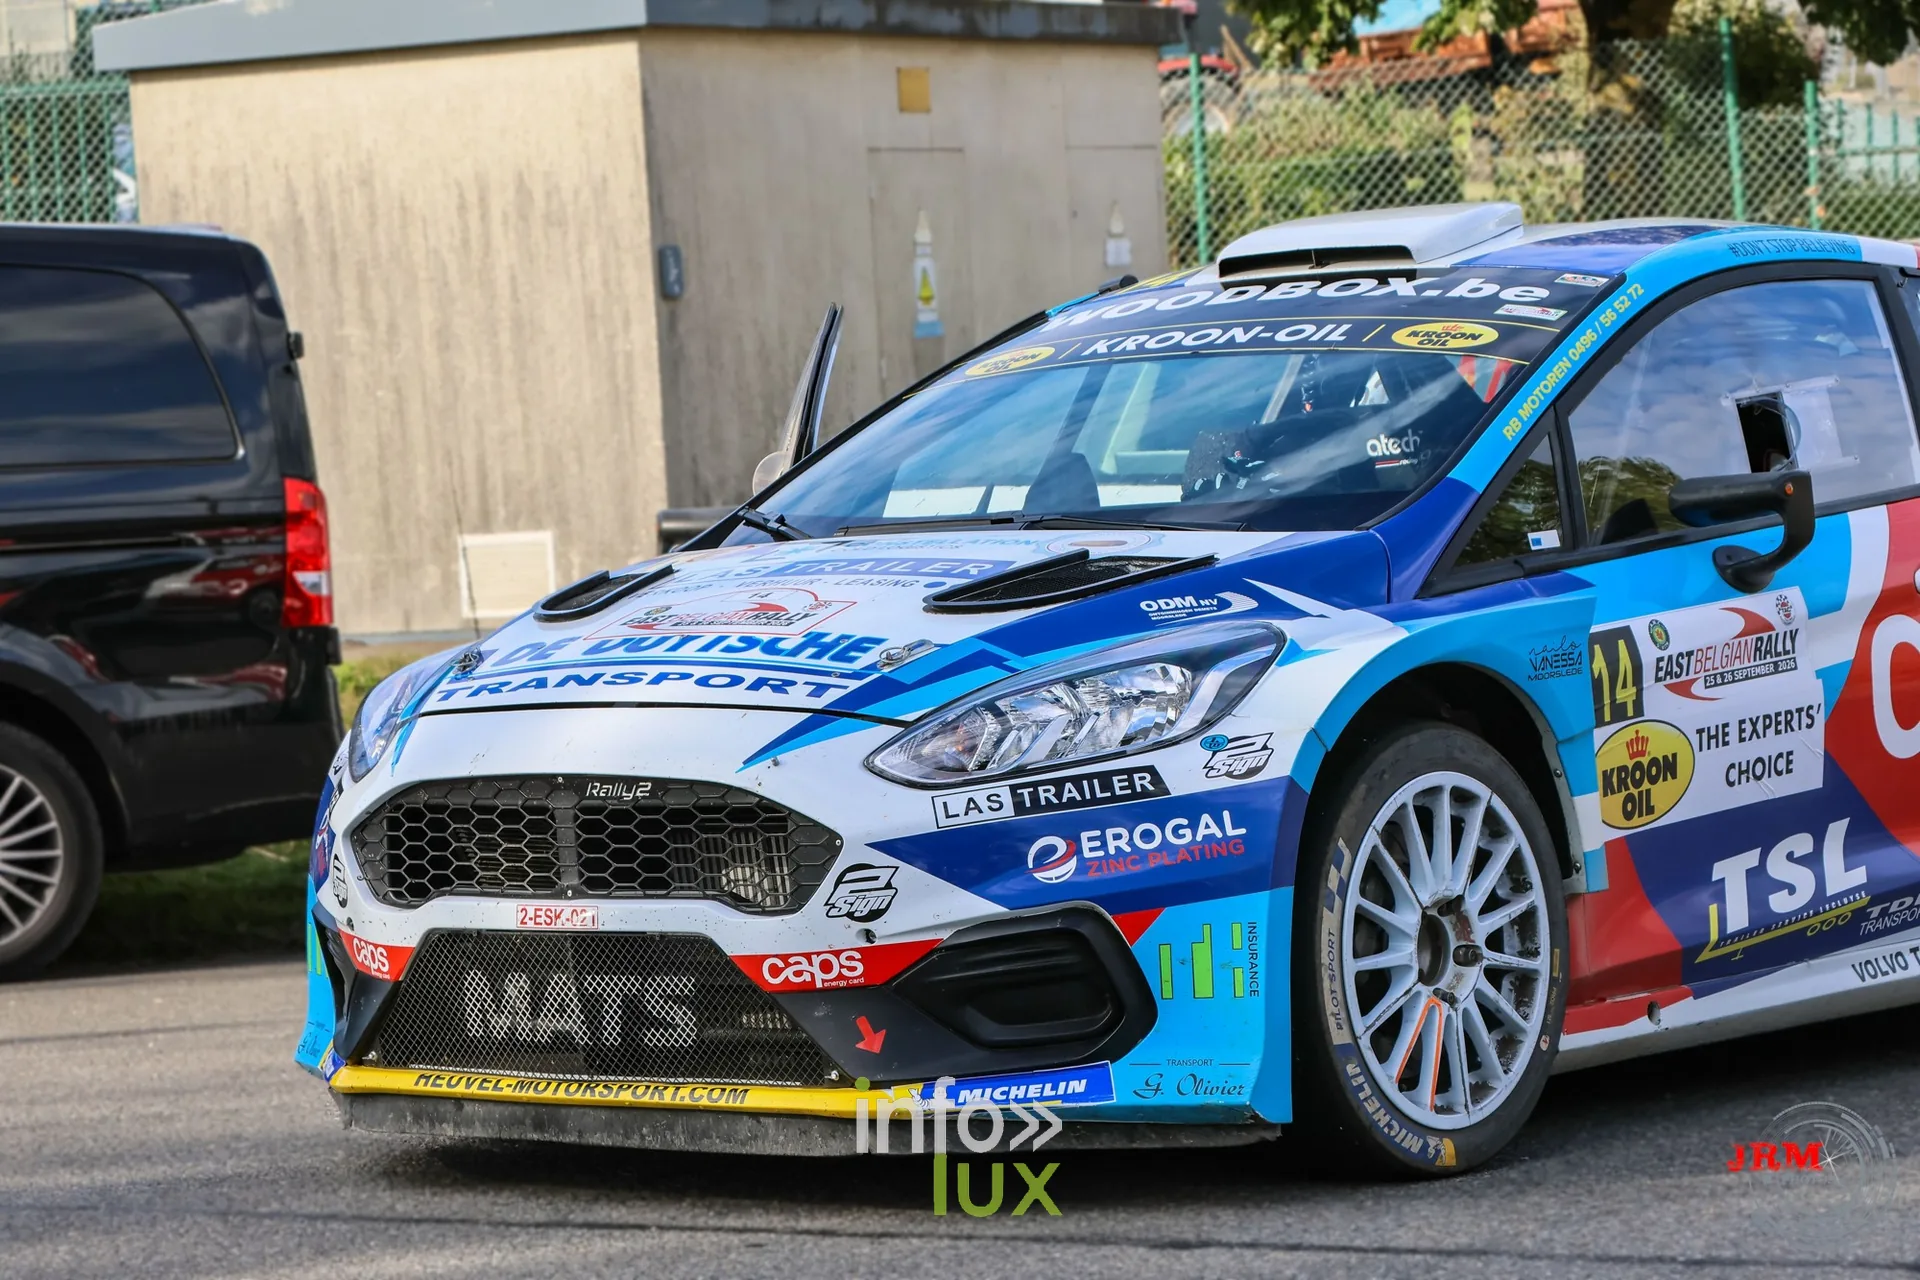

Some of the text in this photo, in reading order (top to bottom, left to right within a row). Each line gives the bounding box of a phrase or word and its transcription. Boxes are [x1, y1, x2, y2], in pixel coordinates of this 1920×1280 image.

[1767, 239, 1798, 253] STOP
[1796, 239, 1856, 255] BELIEVING
[1039, 277, 1551, 332] WOODBOX.be
[1081, 324, 1353, 356] KROON-OIL
[1405, 330, 1484, 341] KROON
[1416, 338, 1450, 347] OIL
[1502, 417, 1522, 441] RB
[1518, 357, 1572, 421] MOTOREN
[1568, 329, 1598, 361] 0496
[1600, 309, 1617, 327] 56
[1613, 297, 1631, 313] 52
[1627, 284, 1644, 299] 72
[1366, 429, 1420, 457] atech
[786, 559, 997, 575] TRAILER
[833, 578, 921, 588] LEASING
[1140, 595, 1198, 611] ODM
[1528, 667, 1583, 682] MOORSLEDE
[1529, 650, 1583, 672] VANESSA
[1705, 659, 1796, 686] 25 & 26 SEPTEMBER 2026
[436, 671, 858, 703] TRANSPORT
[1593, 638, 1638, 722] 14
[1696, 703, 1822, 752] THE EXPERTS'
[1206, 754, 1270, 777] Sign
[1602, 752, 1678, 797] KROON
[1725, 750, 1794, 787] CHOICE
[586, 782, 652, 800] Rally2
[942, 772, 1156, 819] LAS TRAILER
[1622, 788, 1655, 821] OIL
[1080, 810, 1247, 858] EROGAL
[1087, 839, 1245, 876] ZINC PLATING
[1711, 817, 1868, 936] TSL
[826, 894, 894, 918] Sign
[353, 937, 390, 975] caps
[762, 950, 864, 988] caps
[1247, 921, 1260, 998] INSURANCE
[1851, 951, 1909, 983] VOLVO
[823, 977, 865, 988] energy card
[1326, 927, 1345, 1031] PILOT SPORT
[464, 970, 698, 1048] MATS
[1166, 1058, 1215, 1067] TRANSPORT
[413, 1073, 753, 1105] HEUVEL-MOTORSPORT.COM
[957, 1079, 1088, 1103] MICHELIN
[1176, 1073, 1246, 1096] Olivier
[1346, 1063, 1424, 1155] MICHELIN
